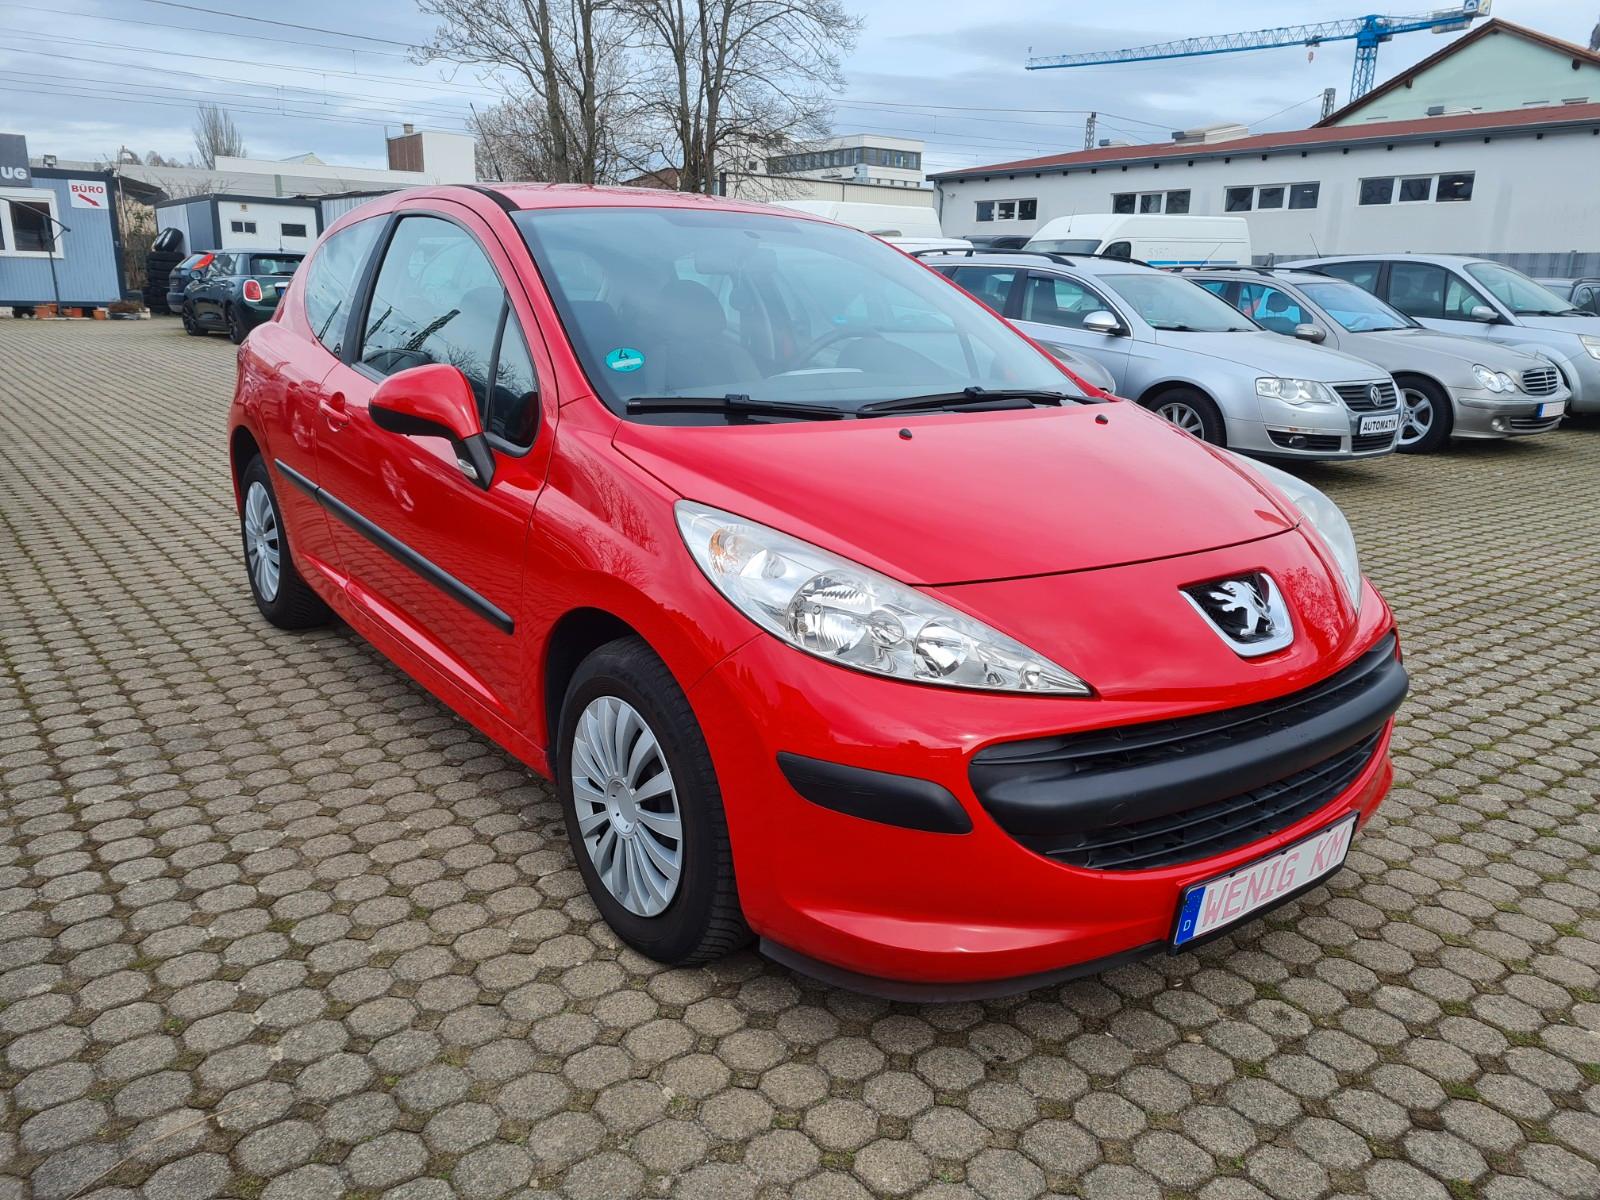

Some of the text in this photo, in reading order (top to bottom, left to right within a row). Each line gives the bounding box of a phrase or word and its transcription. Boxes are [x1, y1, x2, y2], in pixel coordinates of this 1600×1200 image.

[71, 183, 104, 194] BÜRO
[1363, 418, 1398, 431] AUTOMATIK
[1183, 825, 1347, 932] D WENIG KM
